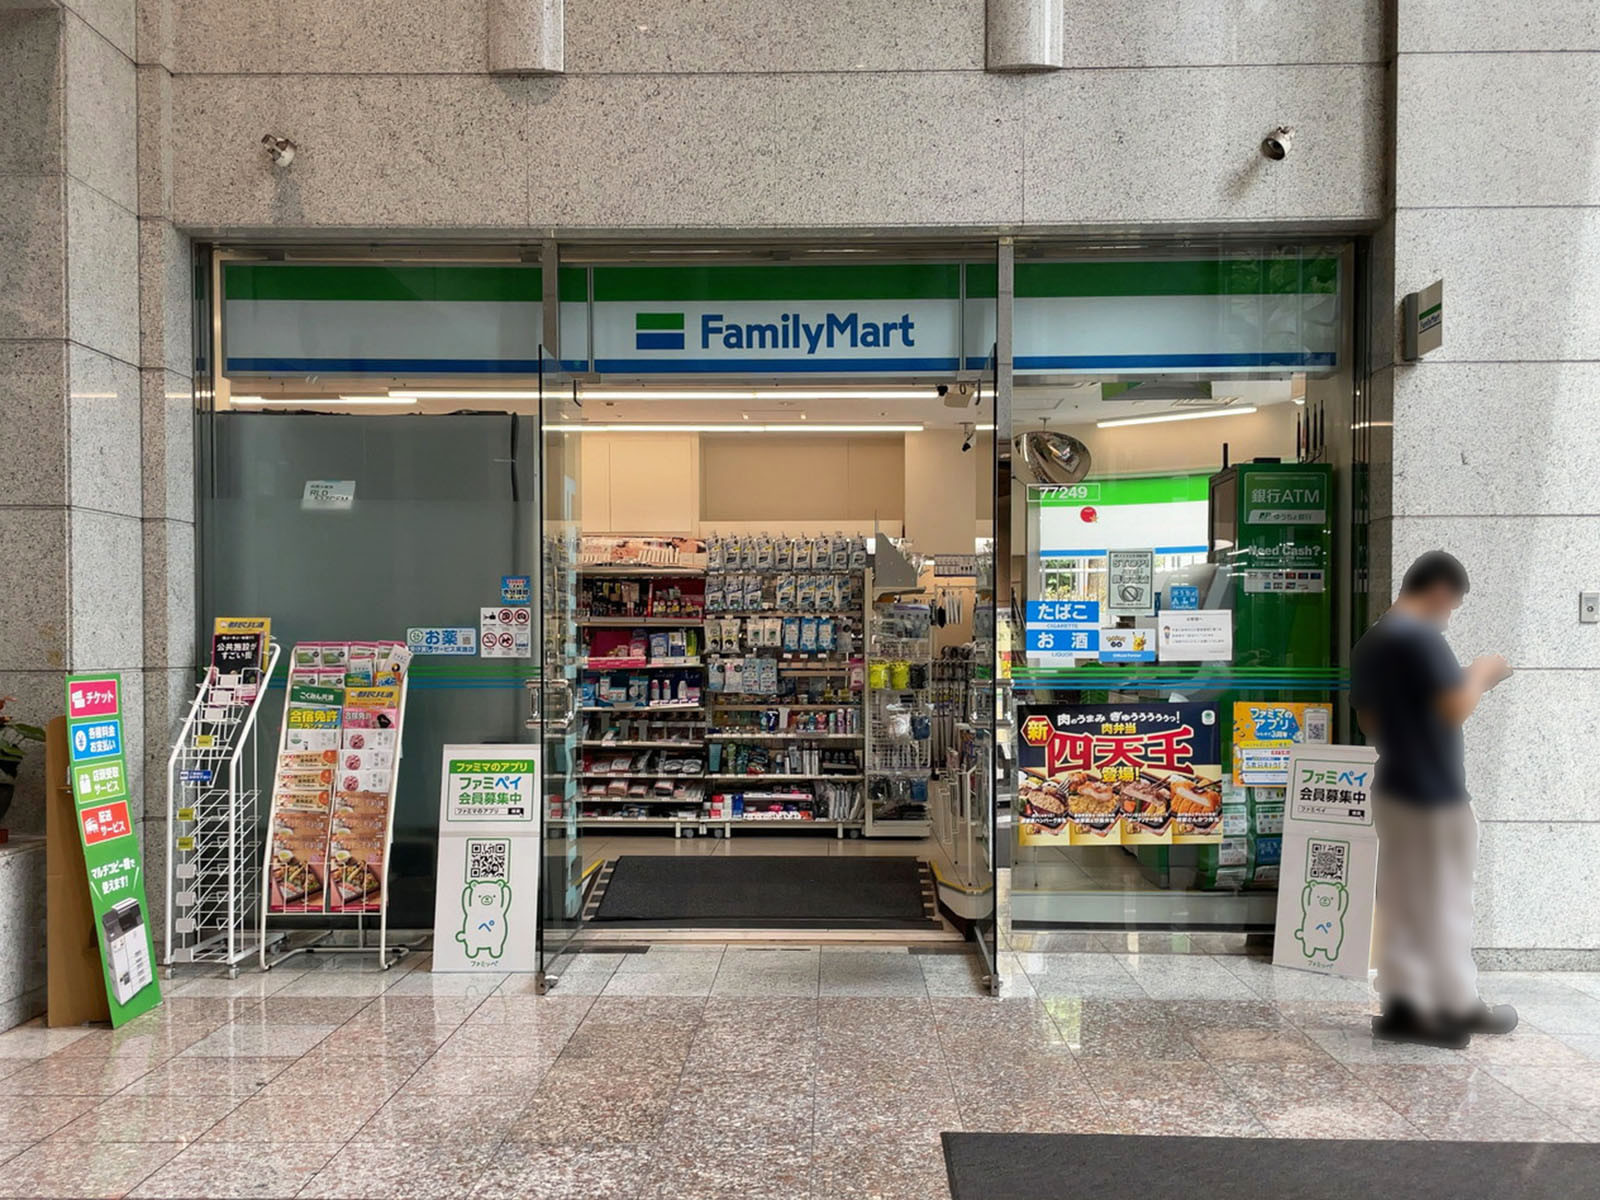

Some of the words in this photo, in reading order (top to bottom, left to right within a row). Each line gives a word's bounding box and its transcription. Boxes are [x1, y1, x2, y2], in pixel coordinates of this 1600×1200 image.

[701, 313, 915, 354] FamilyMart
[1039, 486, 1088, 498] 77249
[1252, 489, 1320, 503] 銀行ATM
[1249, 545, 1279, 556] Need
[1283, 545, 1321, 556] Cash?
[1038, 603, 1088, 620] たばこ
[425, 630, 457, 645] お薬
[86, 690, 114, 704] チケット
[290, 710, 338, 723] 合宿免許
[1056, 713, 1106, 726] 肉のうまみ
[1249, 708, 1293, 719] ファミマの
[1027, 720, 1048, 741] 新
[1101, 722, 1136, 734] 肉弁当
[1254, 718, 1289, 730] アプリ
[1046, 724, 1194, 778] 四天王
[456, 762, 528, 774] ファミマのアプリ
[1101, 766, 1140, 783] 登場!
[459, 776, 522, 790] ファミペイ
[1301, 769, 1368, 787] ファミペイ
[94, 780, 120, 795] サービス
[458, 793, 522, 806] 会員募集中
[1300, 787, 1366, 805] 会員募集中
[100, 820, 126, 836] サービス
